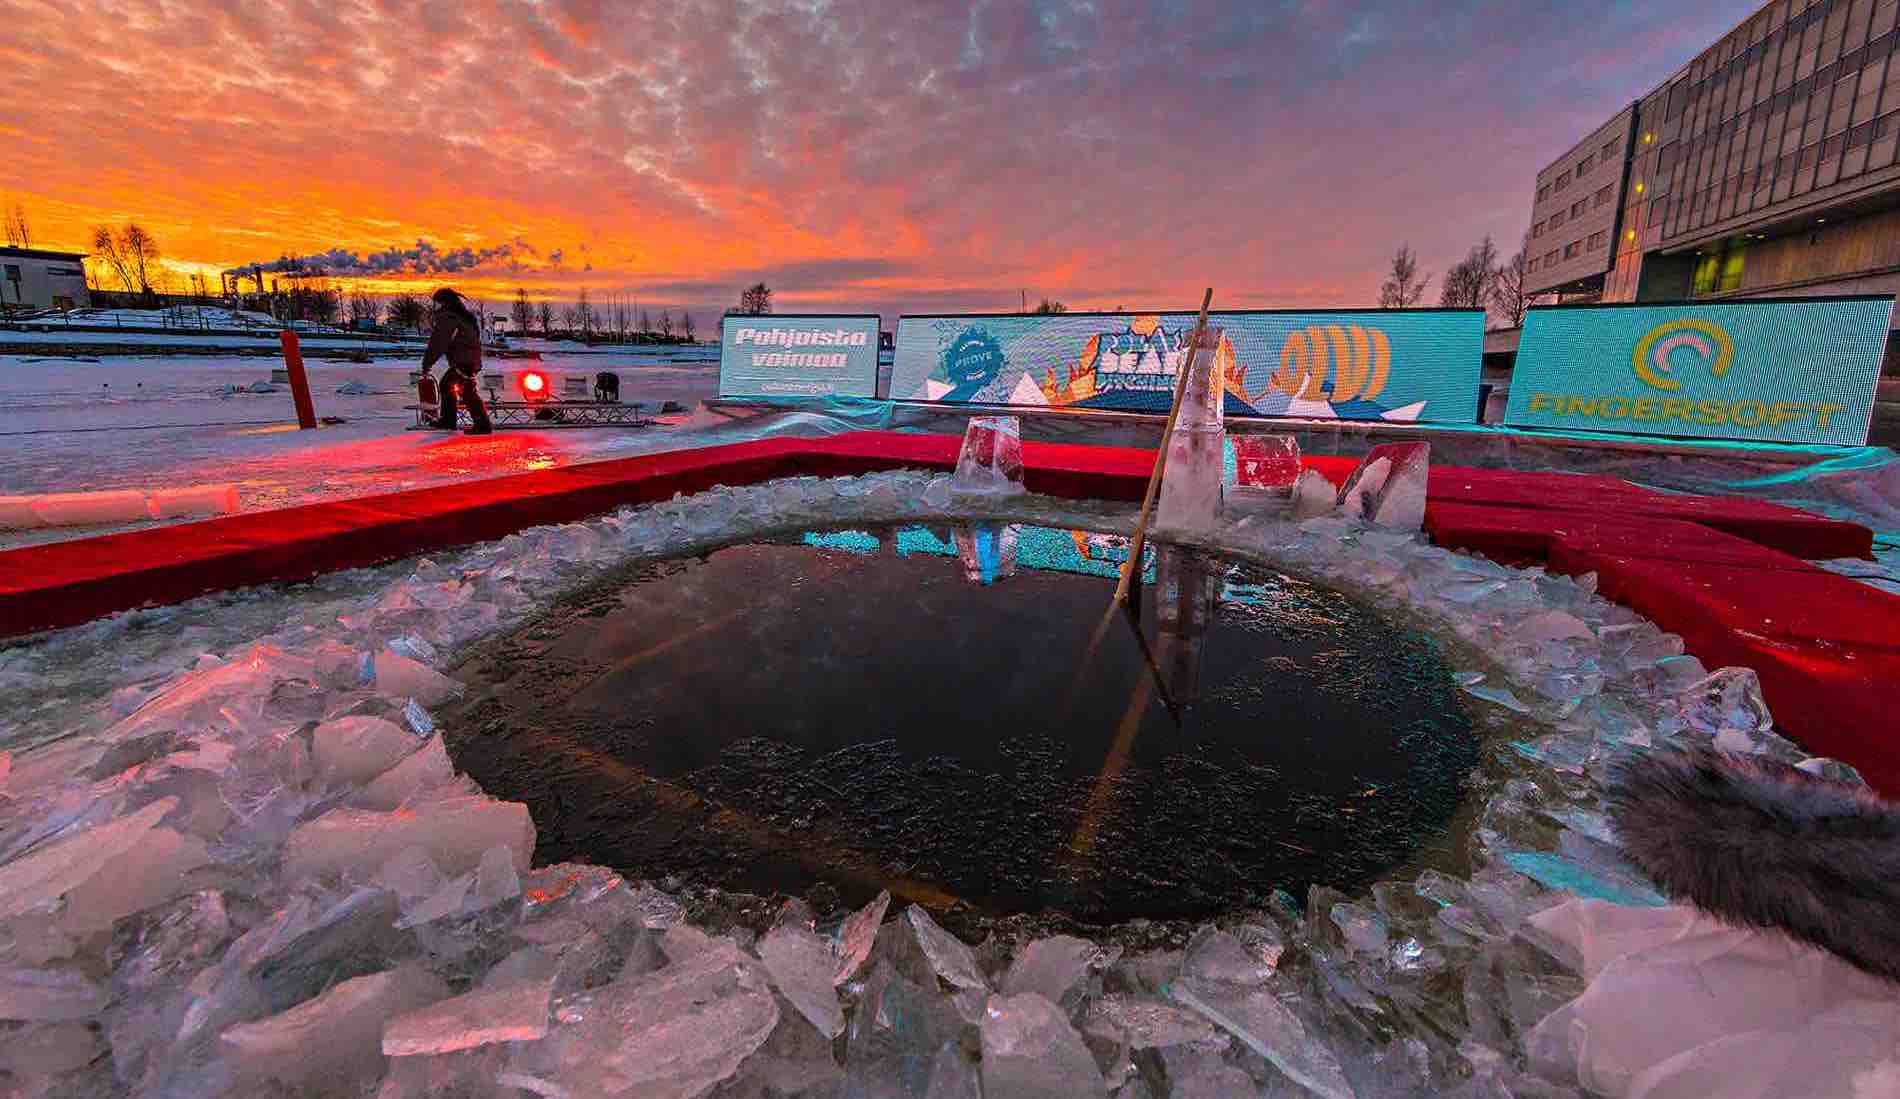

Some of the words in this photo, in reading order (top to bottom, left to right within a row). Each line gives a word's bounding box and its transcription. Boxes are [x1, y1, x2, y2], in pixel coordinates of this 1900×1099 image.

[735, 328, 866, 349] Pohjoista
[752, 351, 849, 369] voimaa
[1529, 392, 1844, 429] FINGERSOFT
